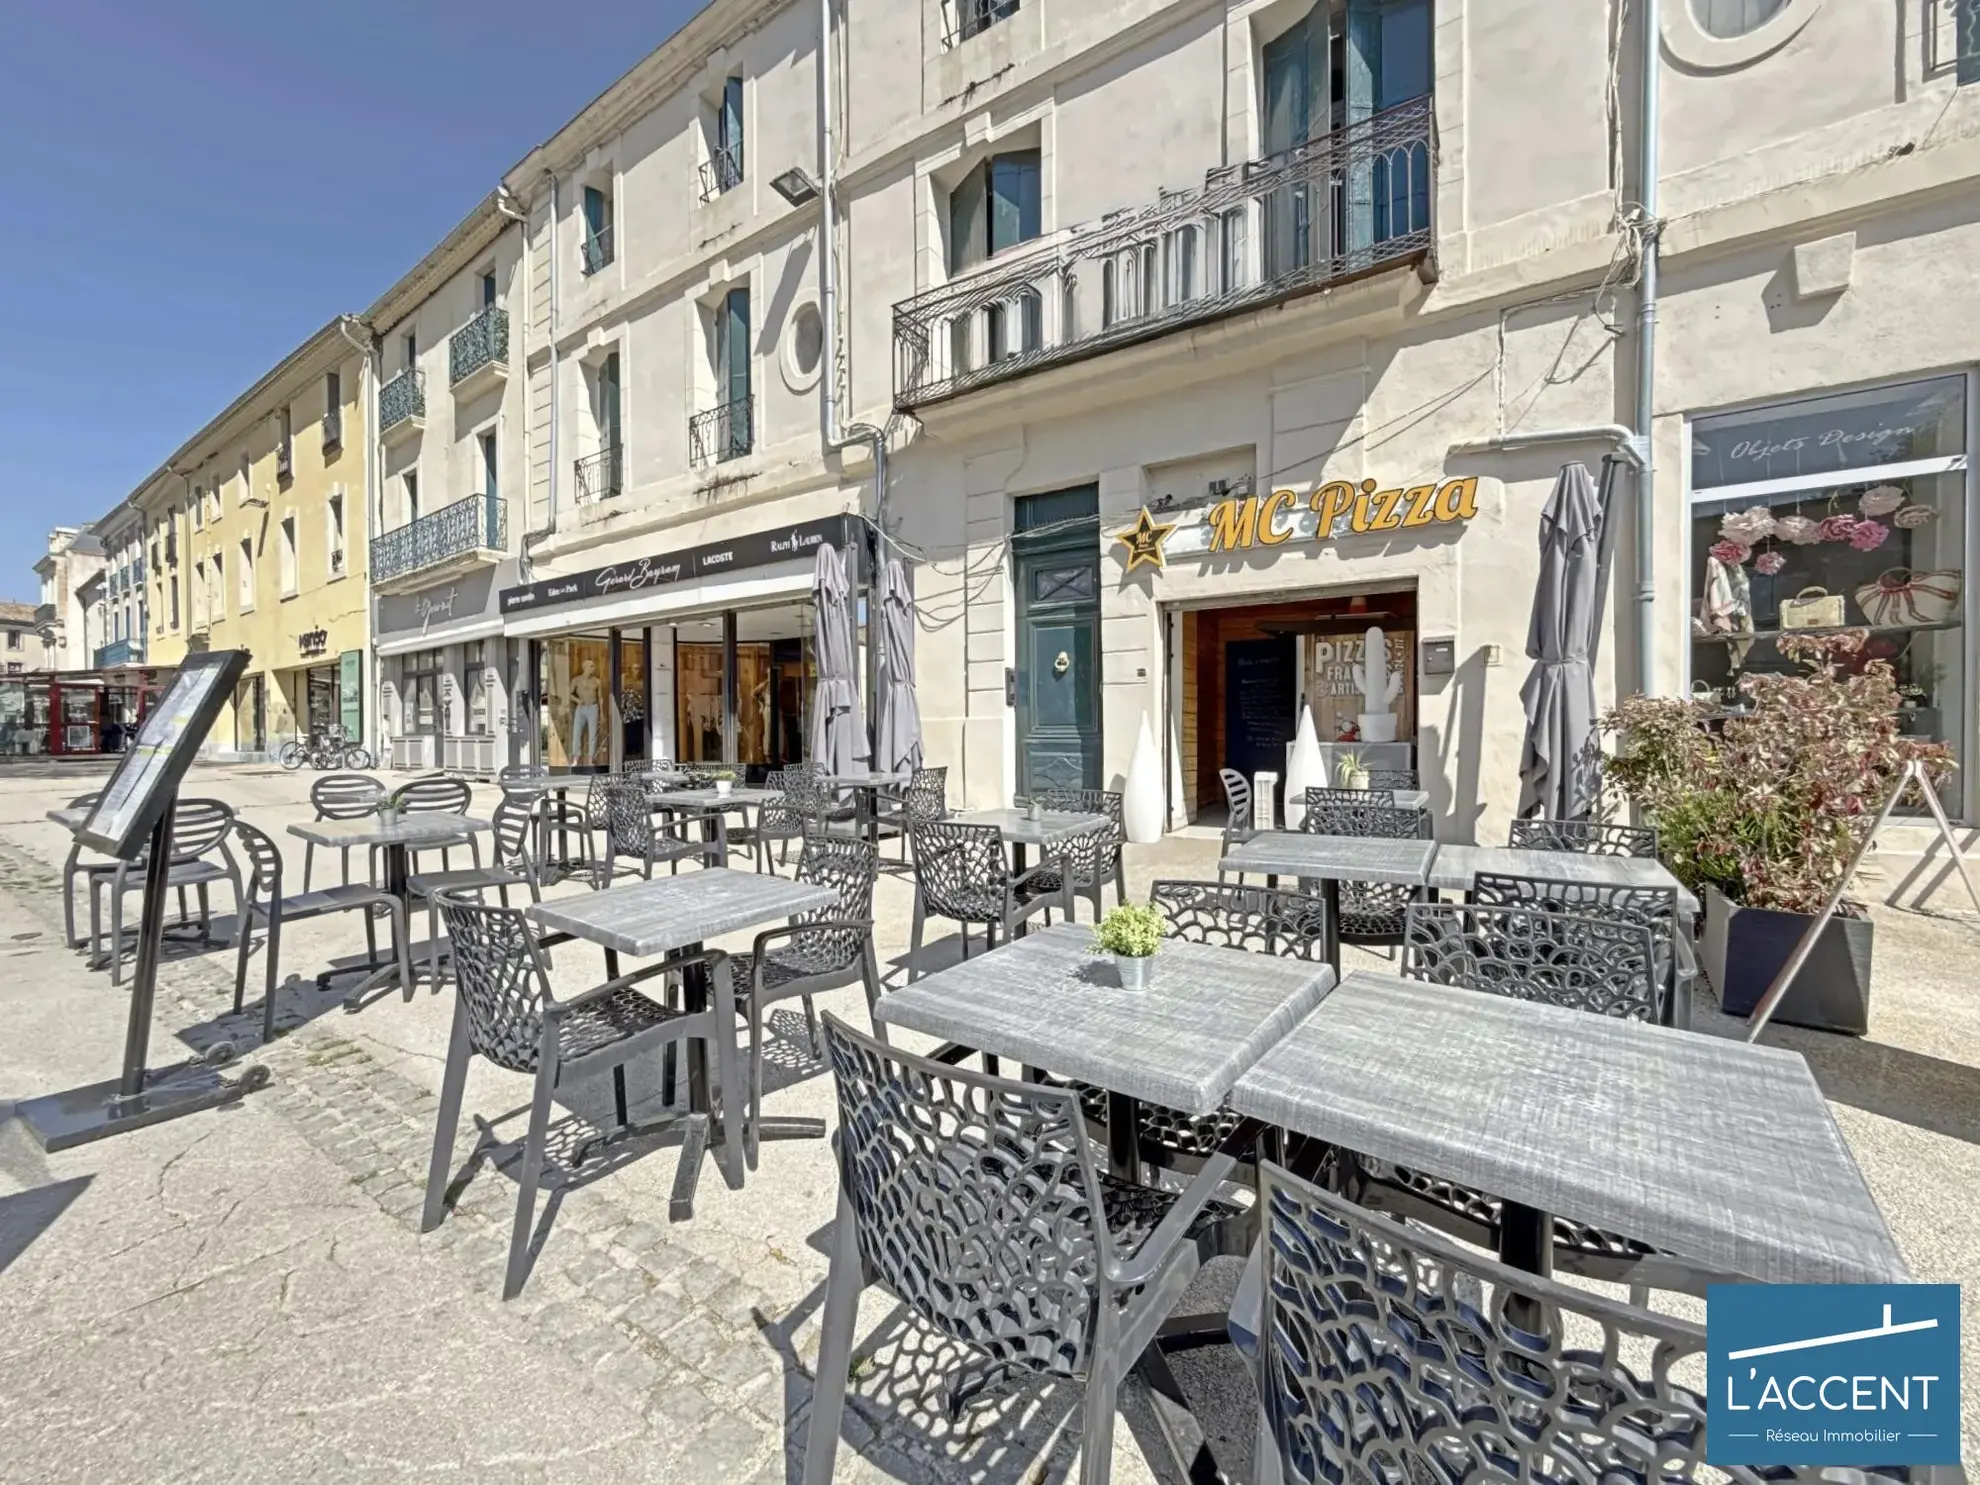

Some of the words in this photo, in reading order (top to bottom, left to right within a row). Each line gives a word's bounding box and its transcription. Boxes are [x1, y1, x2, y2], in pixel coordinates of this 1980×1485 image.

[1731, 437, 1810, 462] Objets
[1818, 422, 1915, 446] Design
[1208, 490, 1296, 552] MC
[1309, 477, 1479, 539] Pizza
[702, 551, 734, 566] LACOSTE
[1315, 639, 1393, 674] PIZZS
